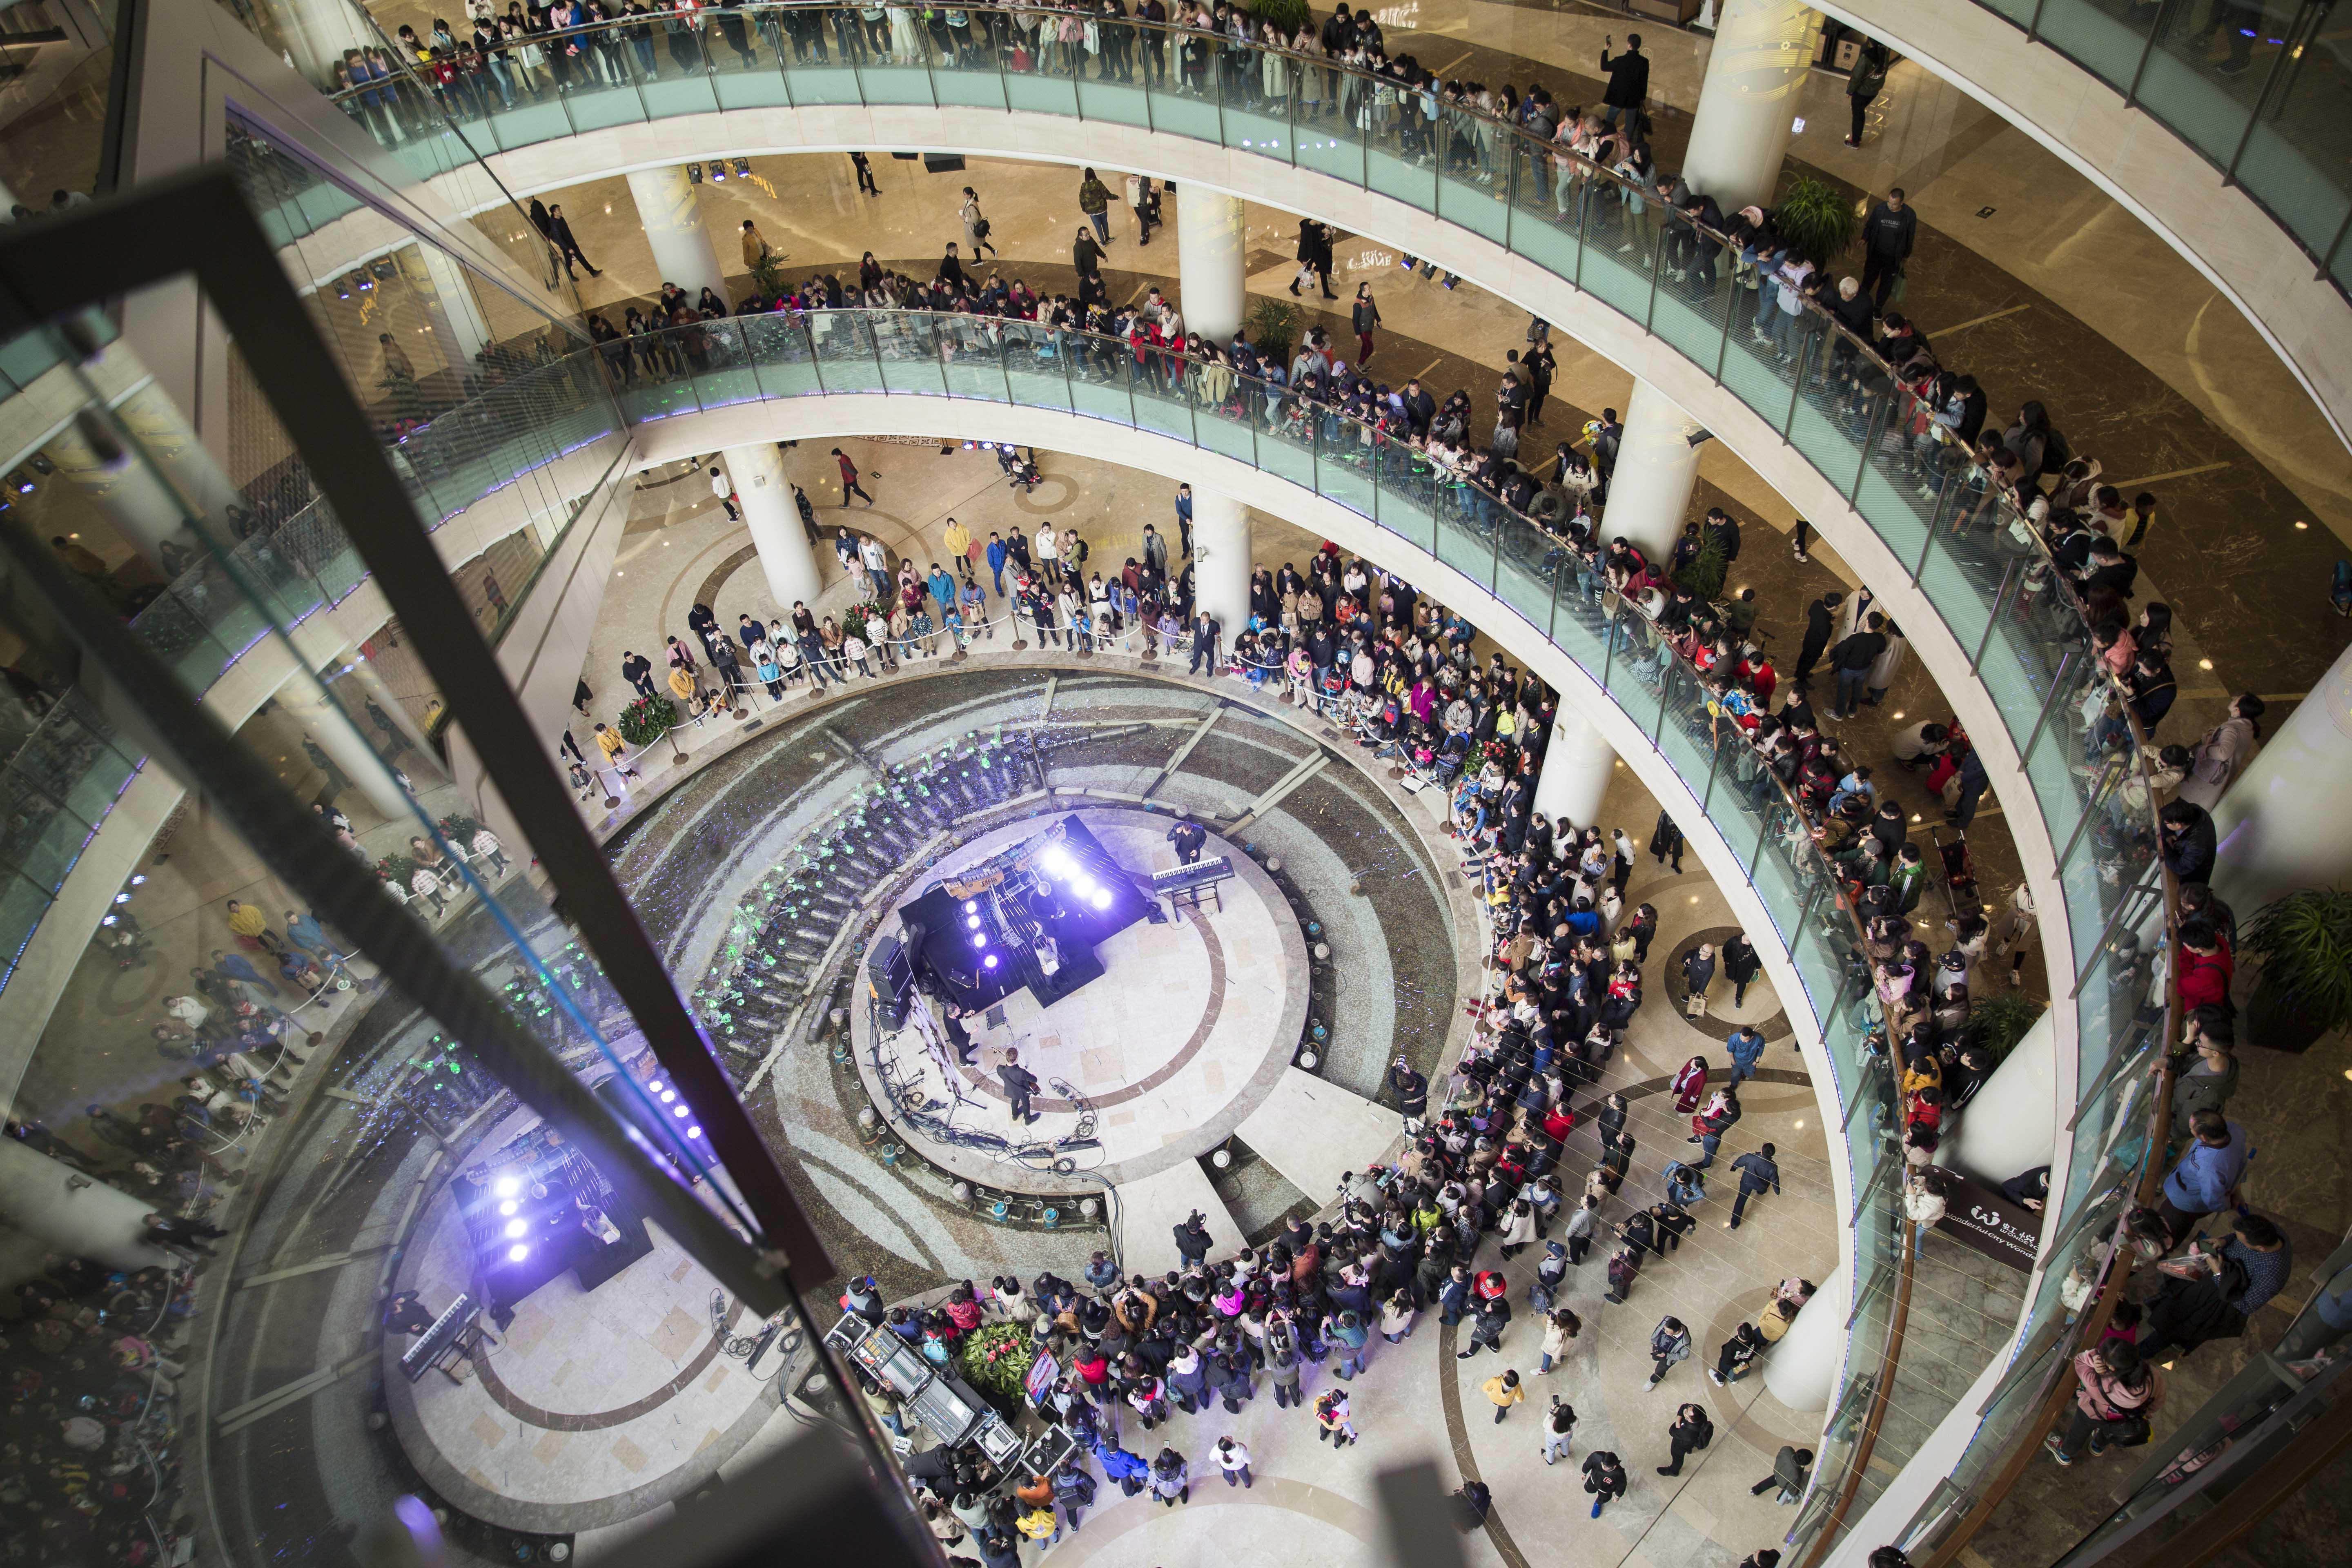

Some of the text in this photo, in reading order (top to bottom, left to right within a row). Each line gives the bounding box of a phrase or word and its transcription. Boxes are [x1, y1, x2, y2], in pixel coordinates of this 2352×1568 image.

[1944, 1212, 1987, 1235] Wonderful
[1988, 1232, 2006, 1243] City
[2002, 1223, 2040, 1246] 虹悦
